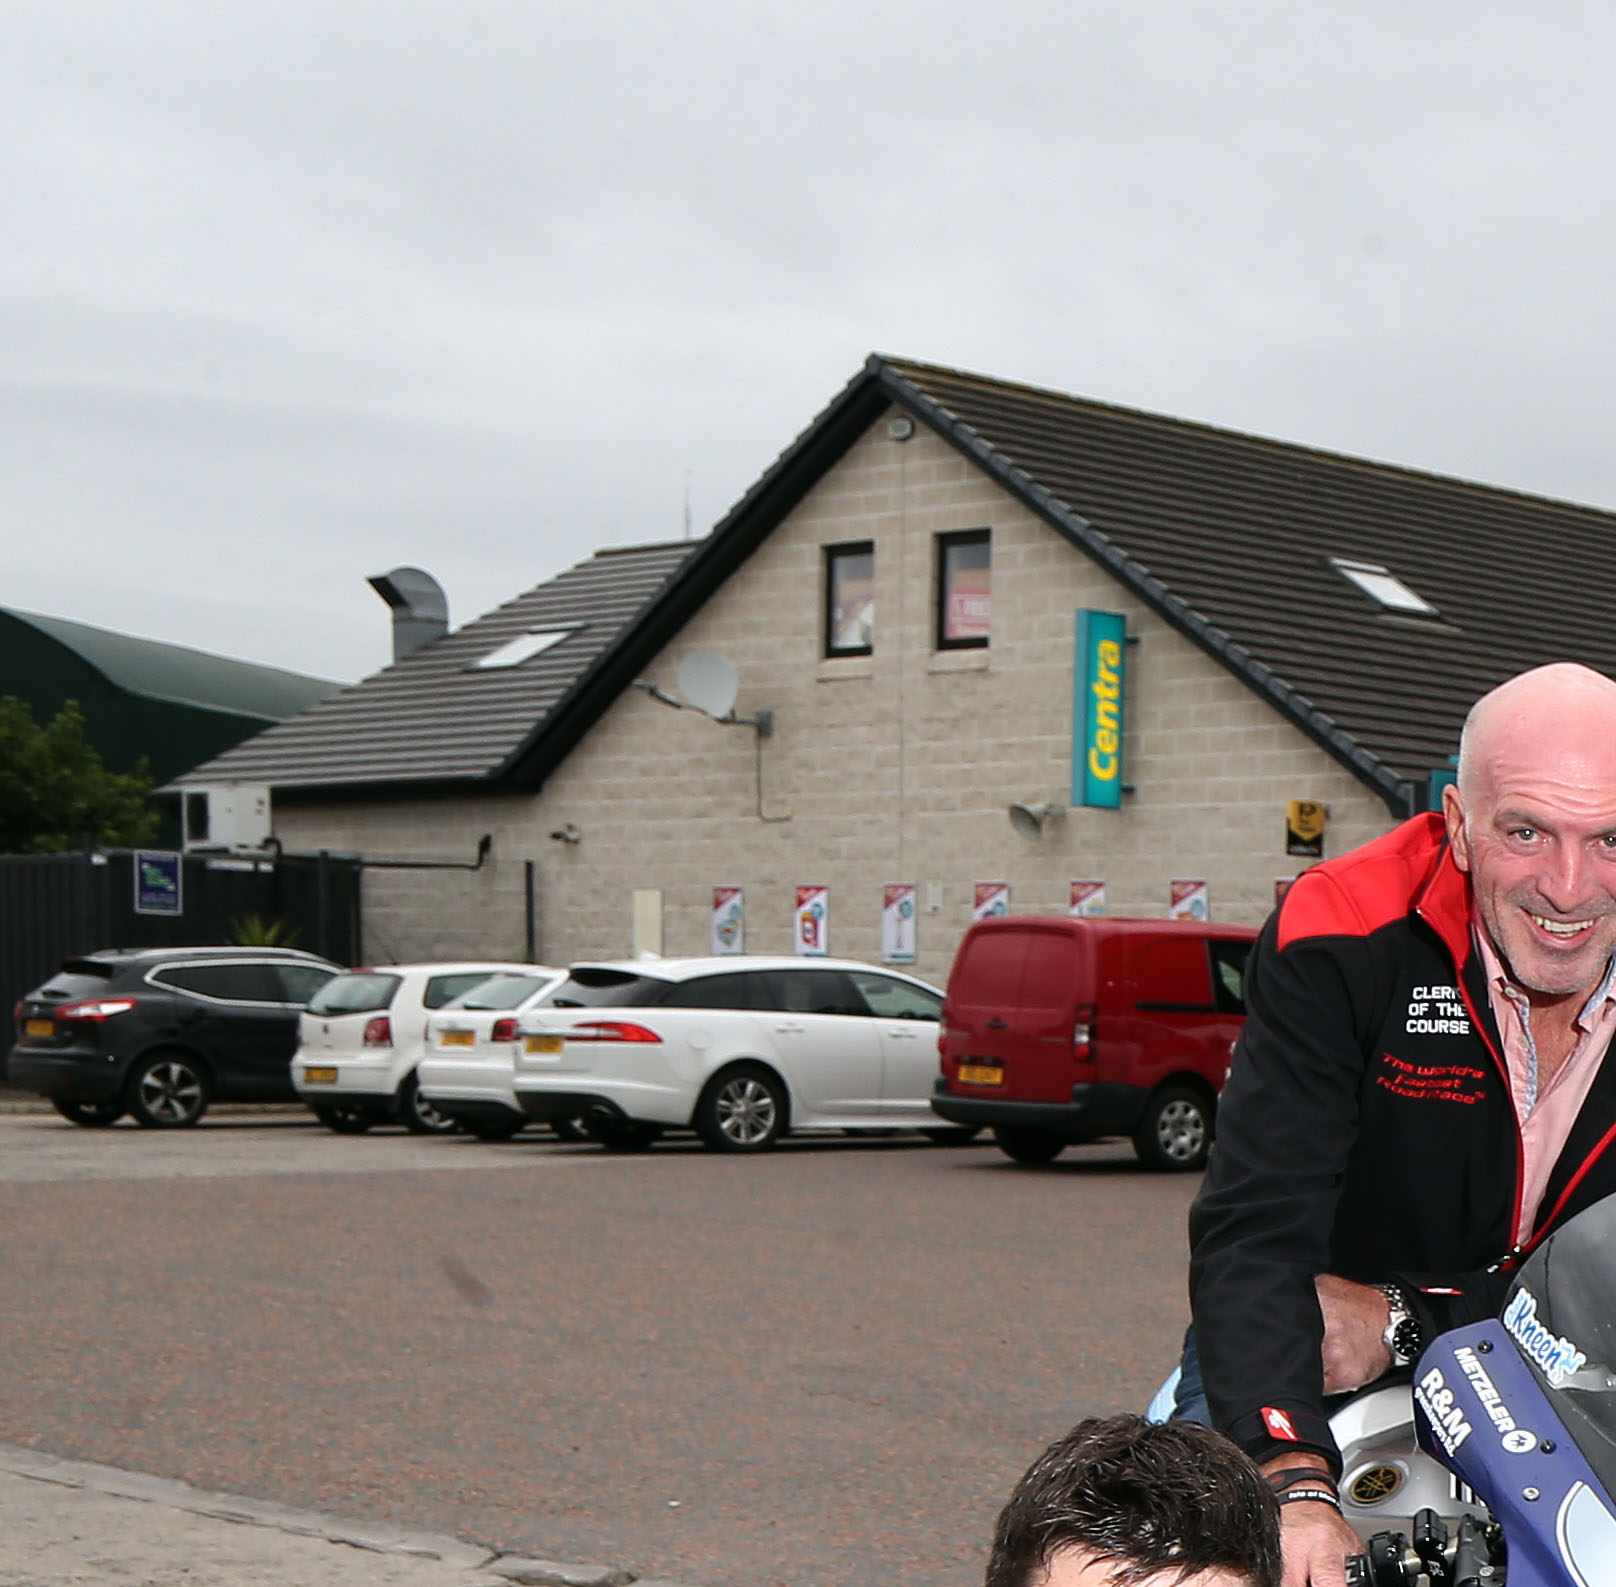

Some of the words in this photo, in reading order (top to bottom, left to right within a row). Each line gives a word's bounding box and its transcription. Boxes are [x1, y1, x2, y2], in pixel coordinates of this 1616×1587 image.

[1088, 638, 1122, 782] Centra
[1405, 1019, 1470, 1035] COURSE
[1408, 1002, 1428, 1017] OF
[1420, 1368, 1472, 1448] R&M
[1454, 1347, 1517, 1433] METZELER
